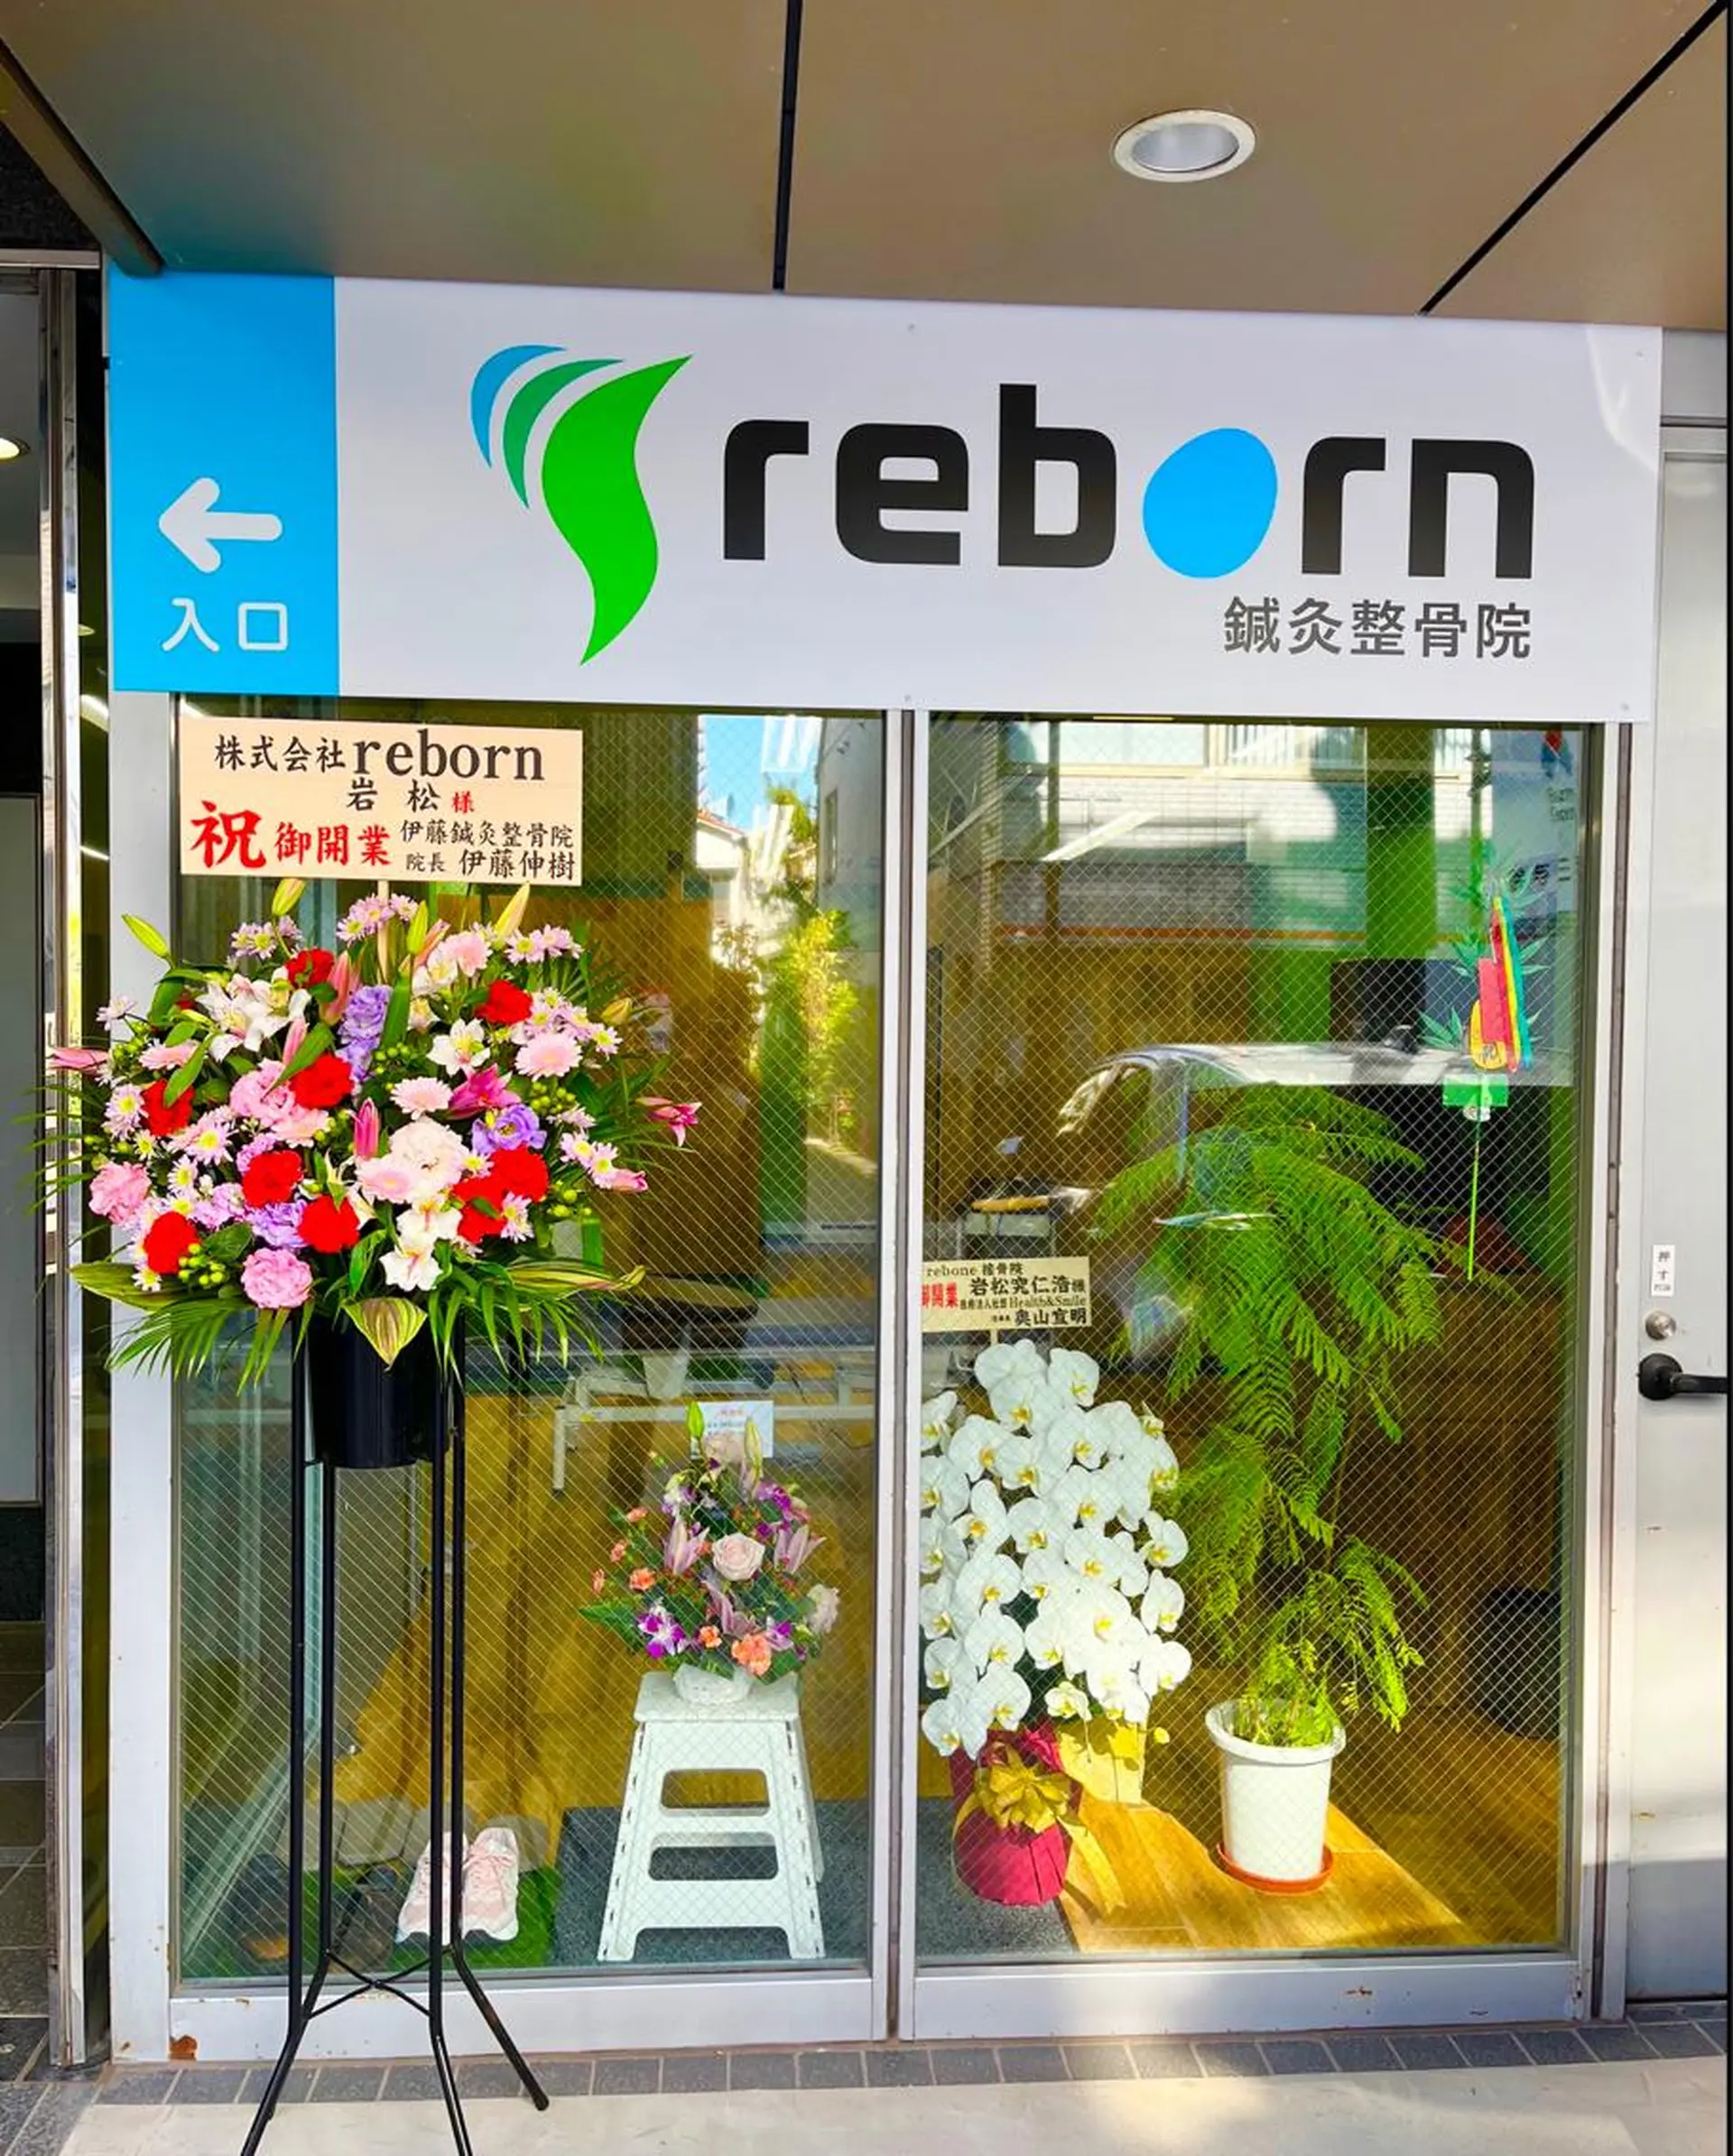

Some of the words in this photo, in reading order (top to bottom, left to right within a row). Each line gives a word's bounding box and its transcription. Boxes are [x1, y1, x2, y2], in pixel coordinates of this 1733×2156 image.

[724, 384, 1534, 579] reborn
[162, 597, 288, 652] 入口
[1223, 596, 1532, 659] 鍼灸整骨院
[400, 820, 575, 848] 伊藤鍼灸整骨院
